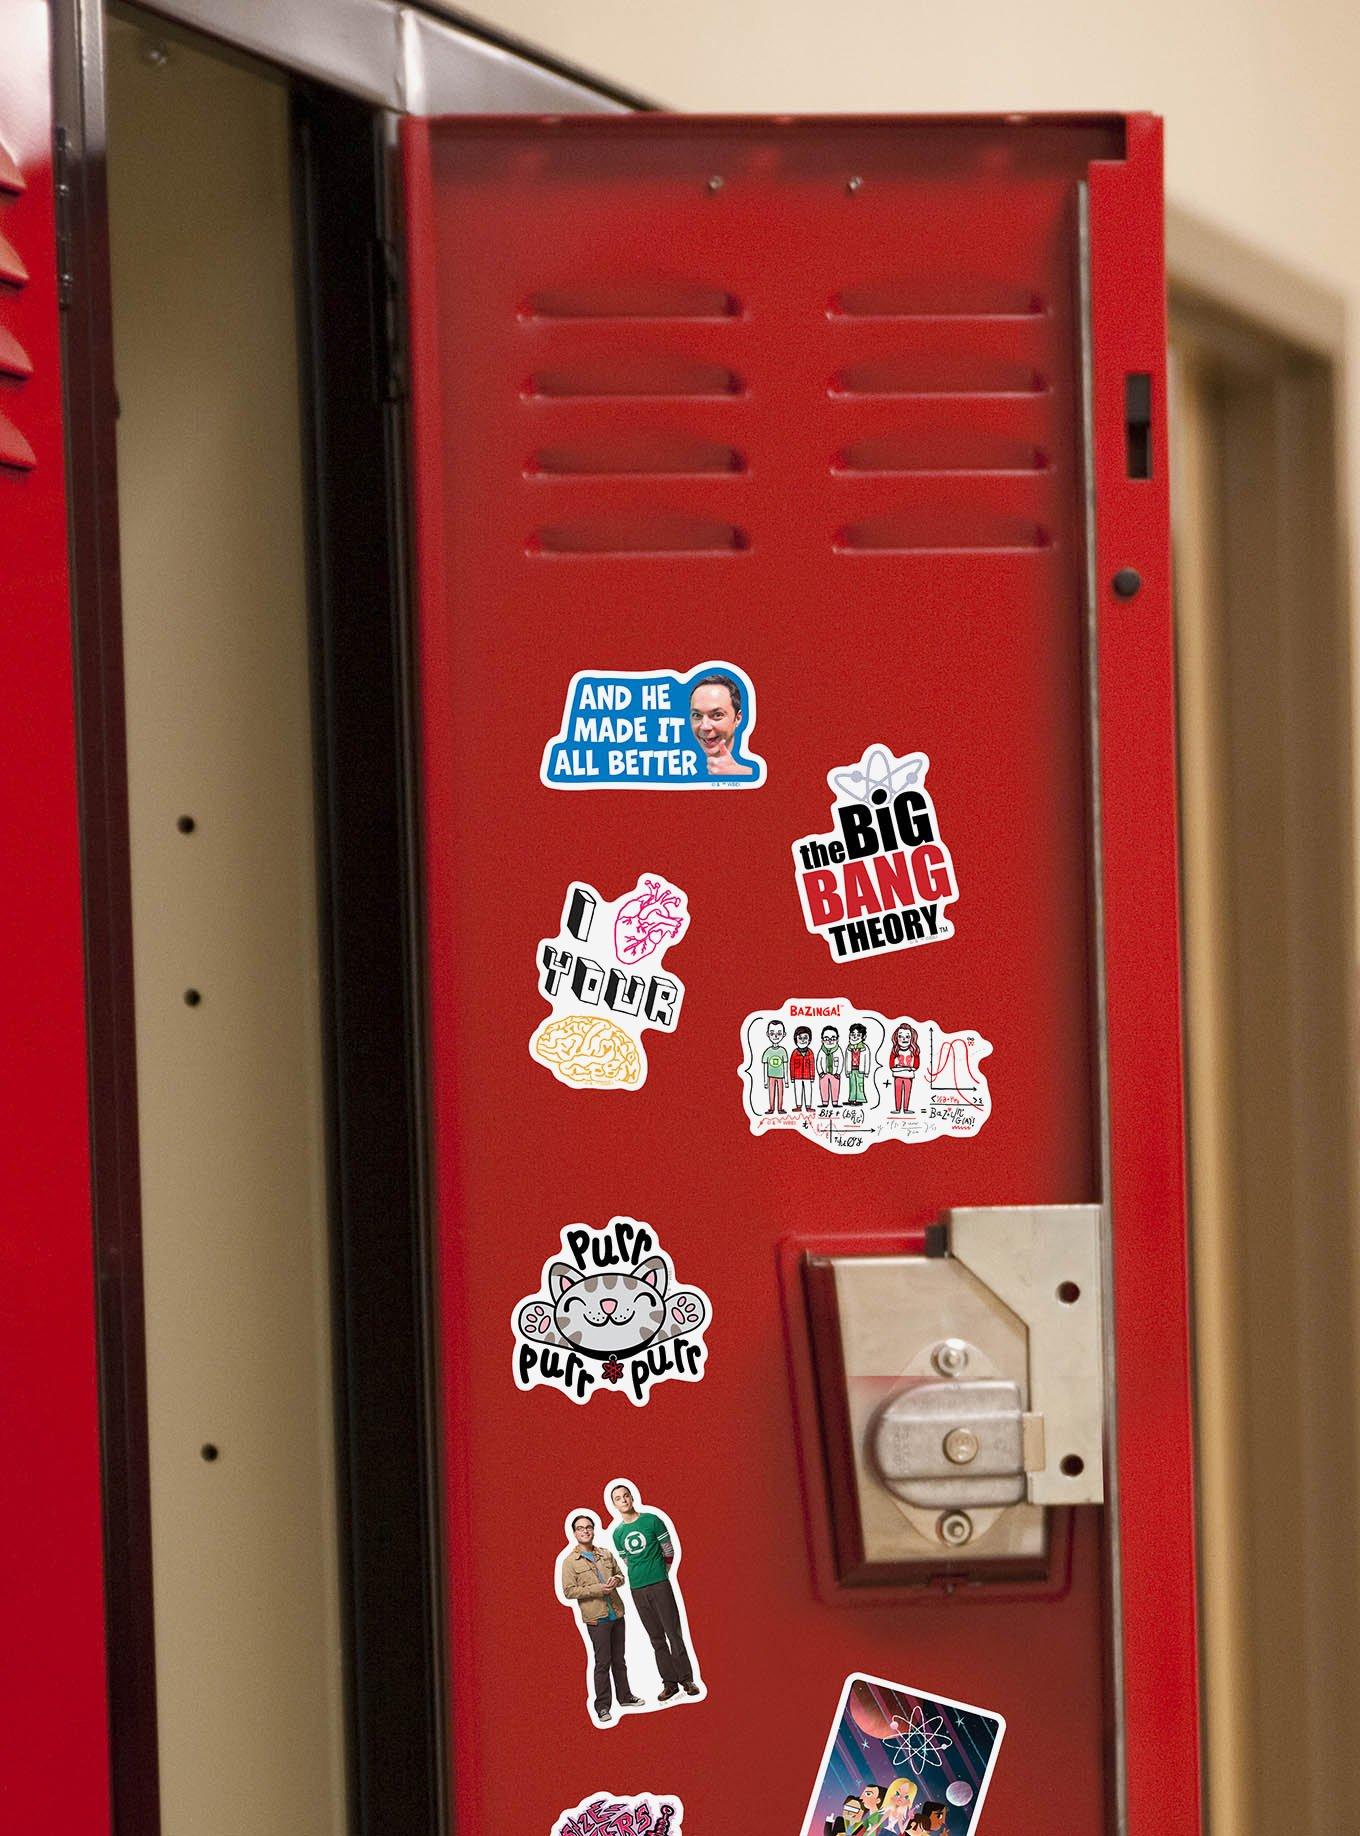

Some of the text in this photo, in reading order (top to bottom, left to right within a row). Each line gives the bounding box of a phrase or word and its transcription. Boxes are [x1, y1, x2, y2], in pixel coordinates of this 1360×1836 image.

[578, 683, 671, 711] AND HE
[574, 716, 685, 743] MADE IT
[554, 749, 698, 777] ALL BETTER
[799, 840, 846, 870] the
[802, 844, 953, 927] BANG
[567, 888, 596, 942] I
[828, 903, 939, 957] THEORY
[543, 945, 678, 1026] YOUR
[790, 1005, 841, 1017] BAZINGA!
